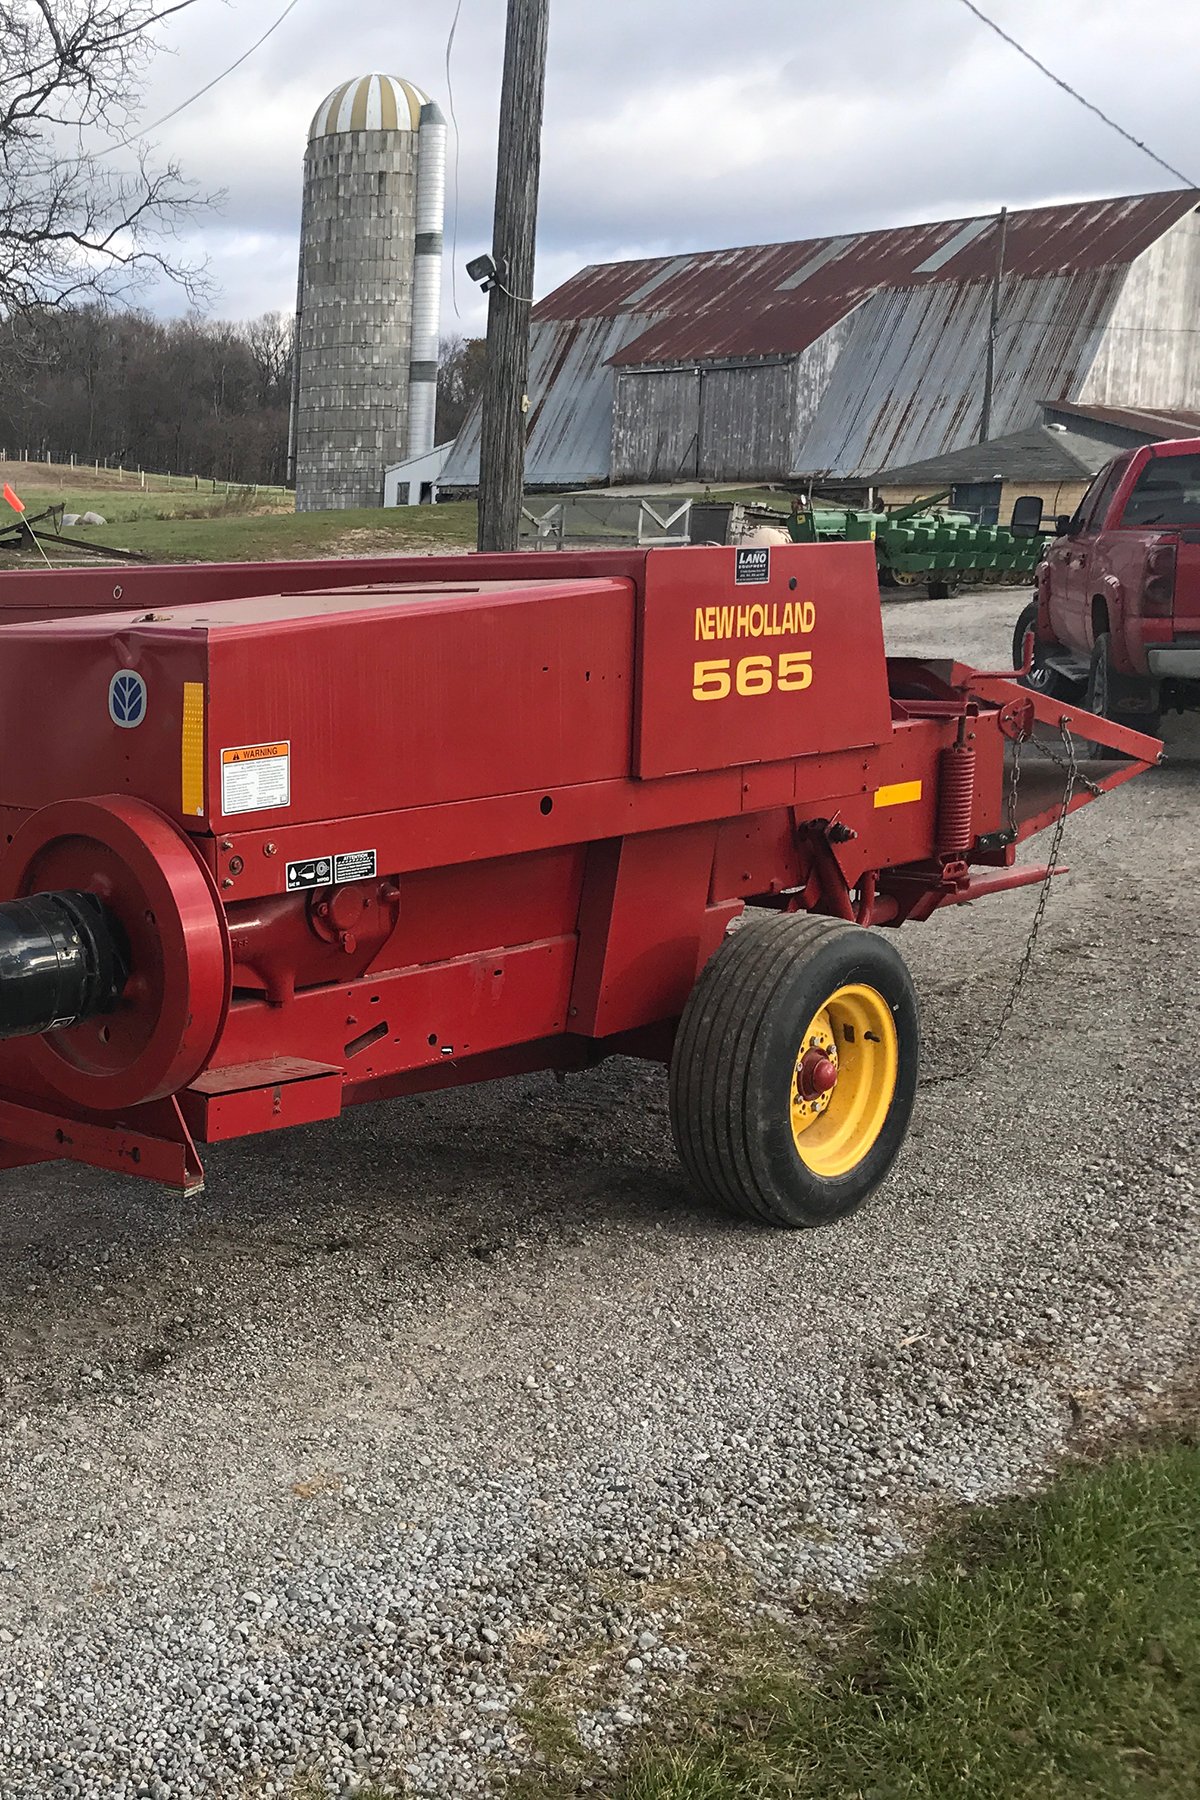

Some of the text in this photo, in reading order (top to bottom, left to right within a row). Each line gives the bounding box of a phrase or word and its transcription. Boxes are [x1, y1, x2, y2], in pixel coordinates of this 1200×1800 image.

[739, 552, 767, 564] LANO
[695, 601, 816, 640] NEW HOLLAND
[692, 650, 813, 701] 565
[242, 747, 278, 759] WARNING
